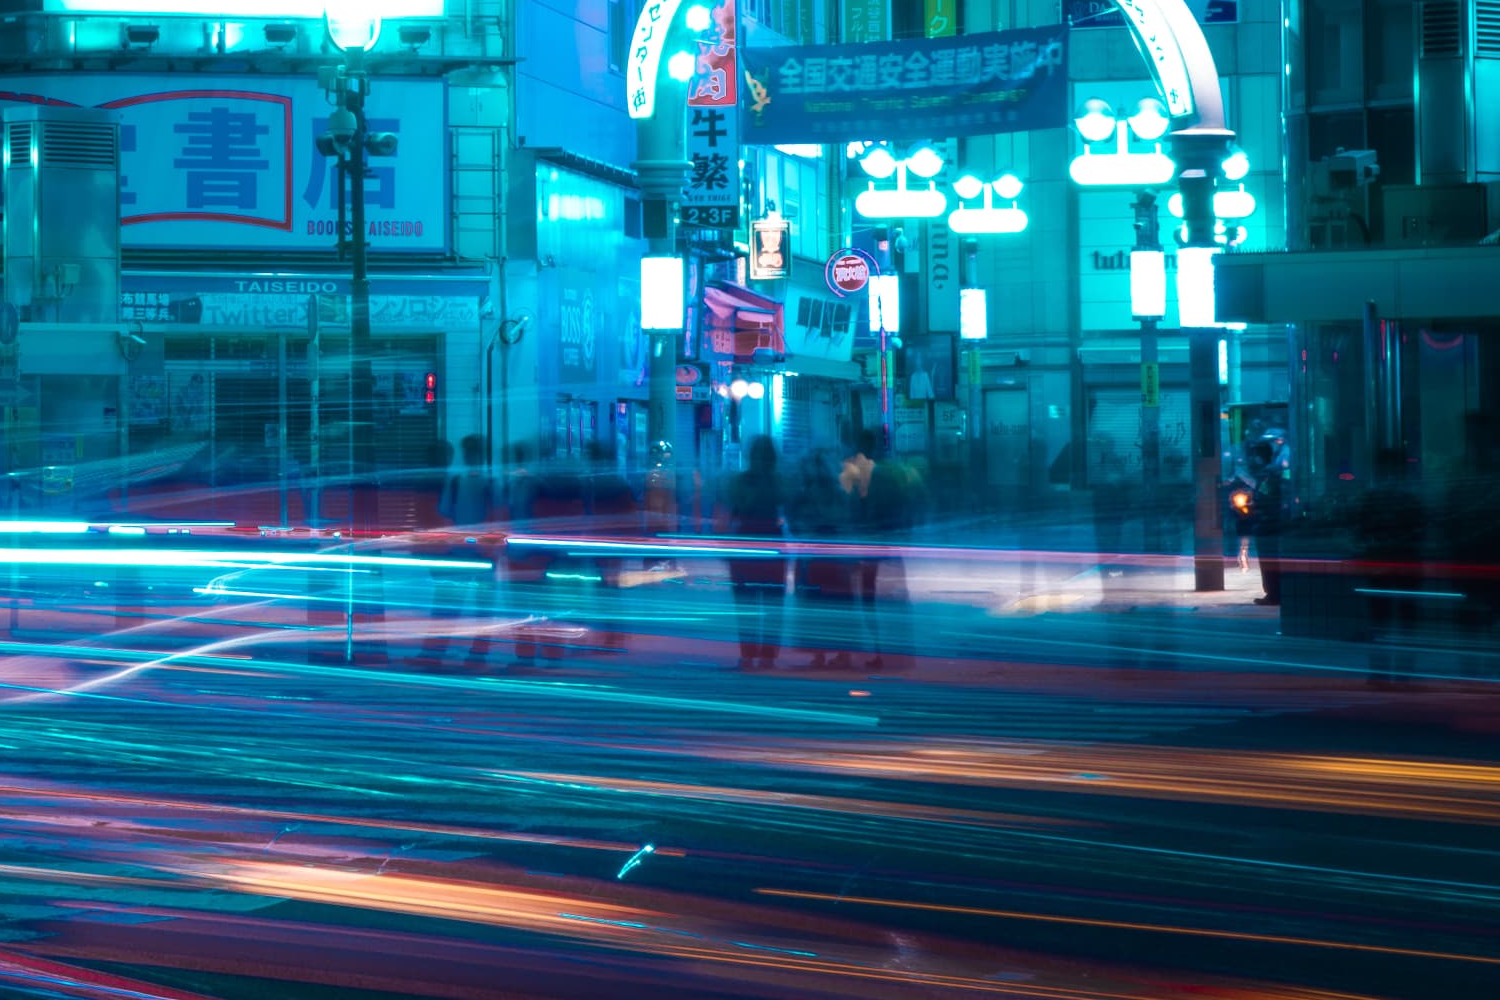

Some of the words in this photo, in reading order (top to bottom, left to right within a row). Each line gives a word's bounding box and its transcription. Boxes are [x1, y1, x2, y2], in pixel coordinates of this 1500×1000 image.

[691, 108, 729, 191] 牛繁
[358, 219, 425, 238] AISEIDO
[233, 280, 339, 294] TAISEIDO
[205, 302, 298, 326] Twitter
